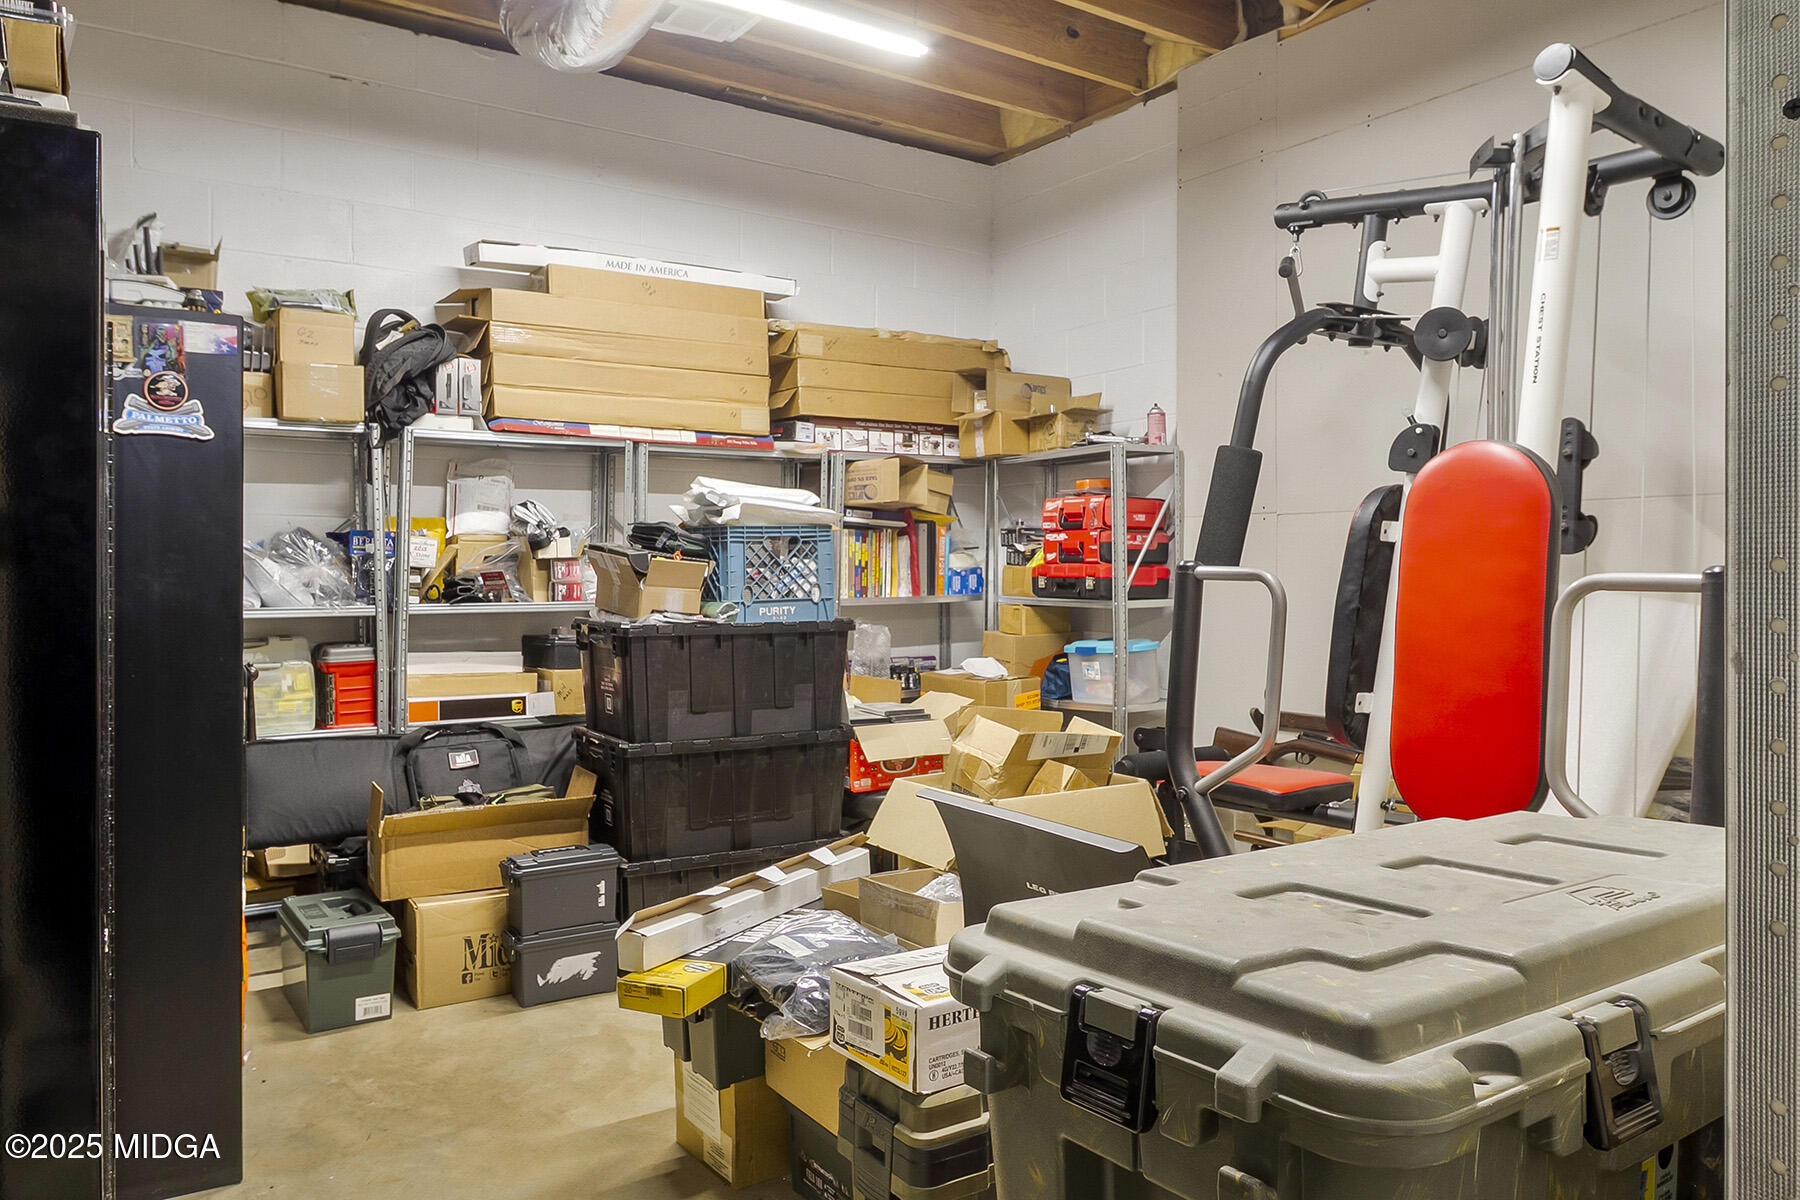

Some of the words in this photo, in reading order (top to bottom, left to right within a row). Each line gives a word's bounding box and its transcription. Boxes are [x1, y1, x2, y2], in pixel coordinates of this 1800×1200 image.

[606, 260, 632, 271] MADE
[635, 263, 647, 272] IN
[648, 265, 689, 278] AMERICA
[1537, 292, 1547, 332] CHEST
[1532, 335, 1543, 384] STATION
[130, 410, 198, 426] PALMETTO
[352, 535, 394, 547] BERTA
[759, 606, 796, 616] PURITY
